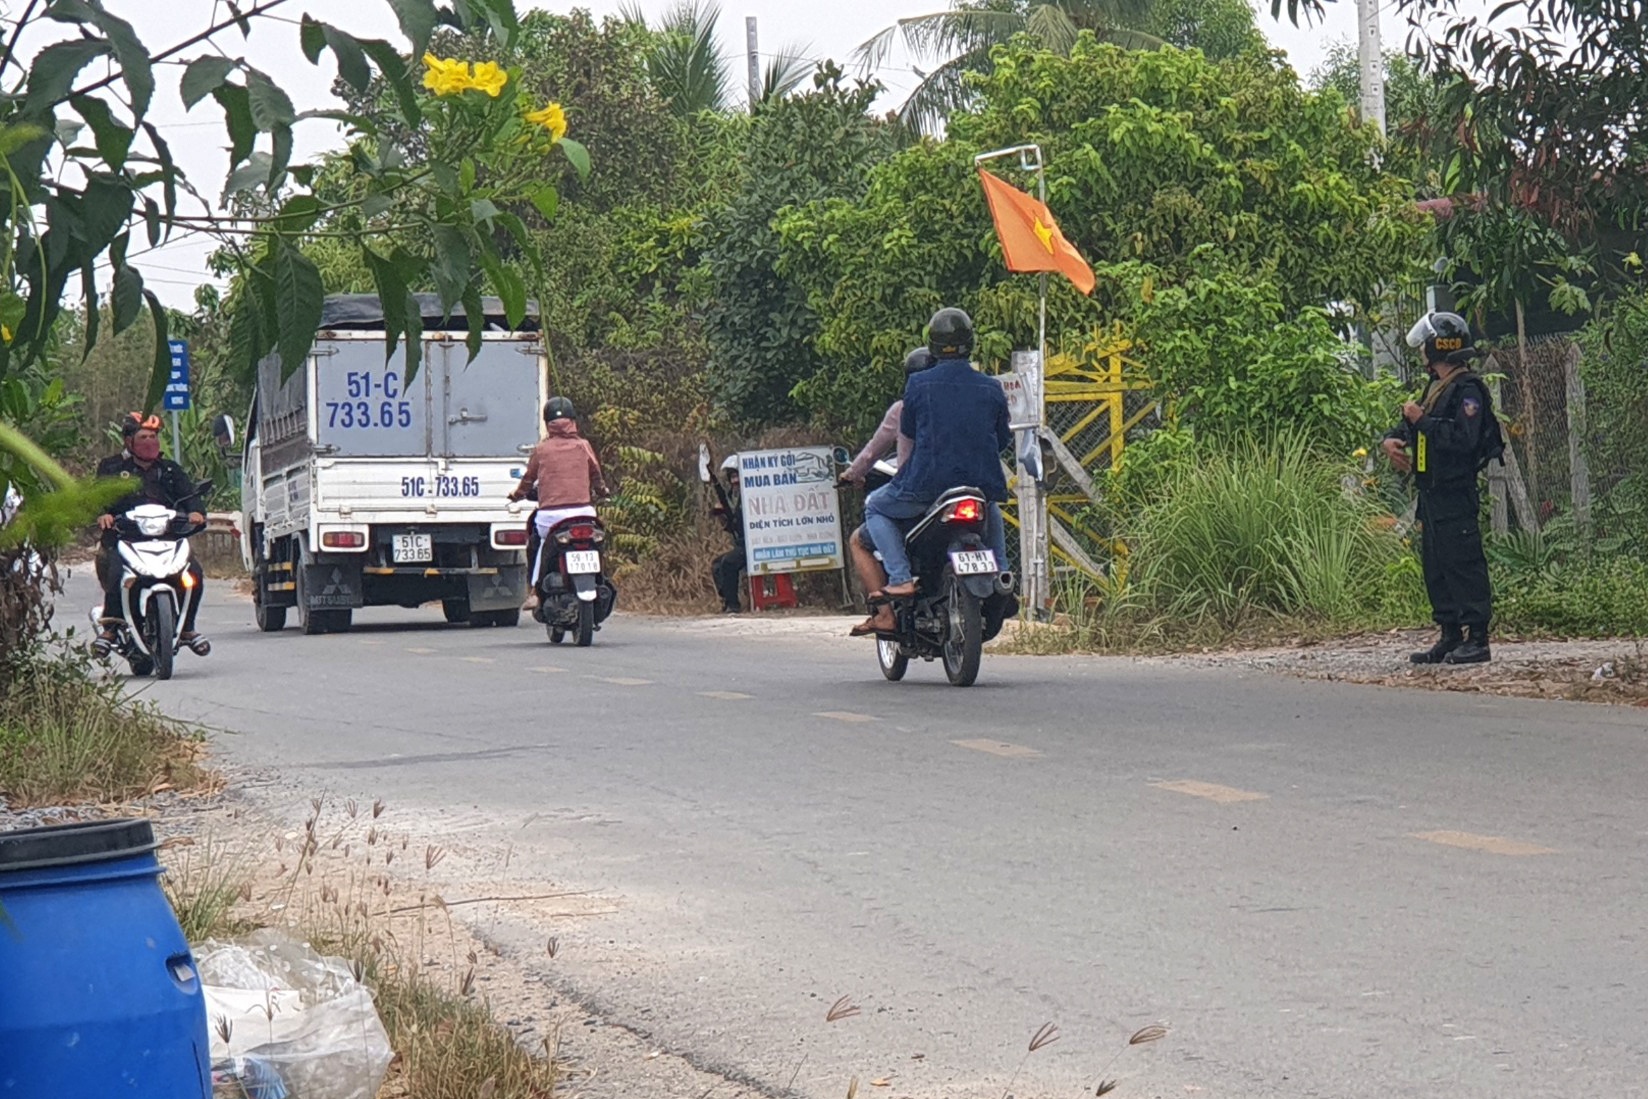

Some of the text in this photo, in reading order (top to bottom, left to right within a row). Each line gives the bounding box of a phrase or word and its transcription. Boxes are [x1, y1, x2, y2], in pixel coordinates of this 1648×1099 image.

[347, 371, 398, 398] 51-C
[326, 402, 411, 428] 733.65
[435, 476, 479, 497] 733.65
[744, 470, 797, 488] MUA BÁN
[773, 517, 793, 528] TÍCH
[401, 535, 423, 548] 51C
